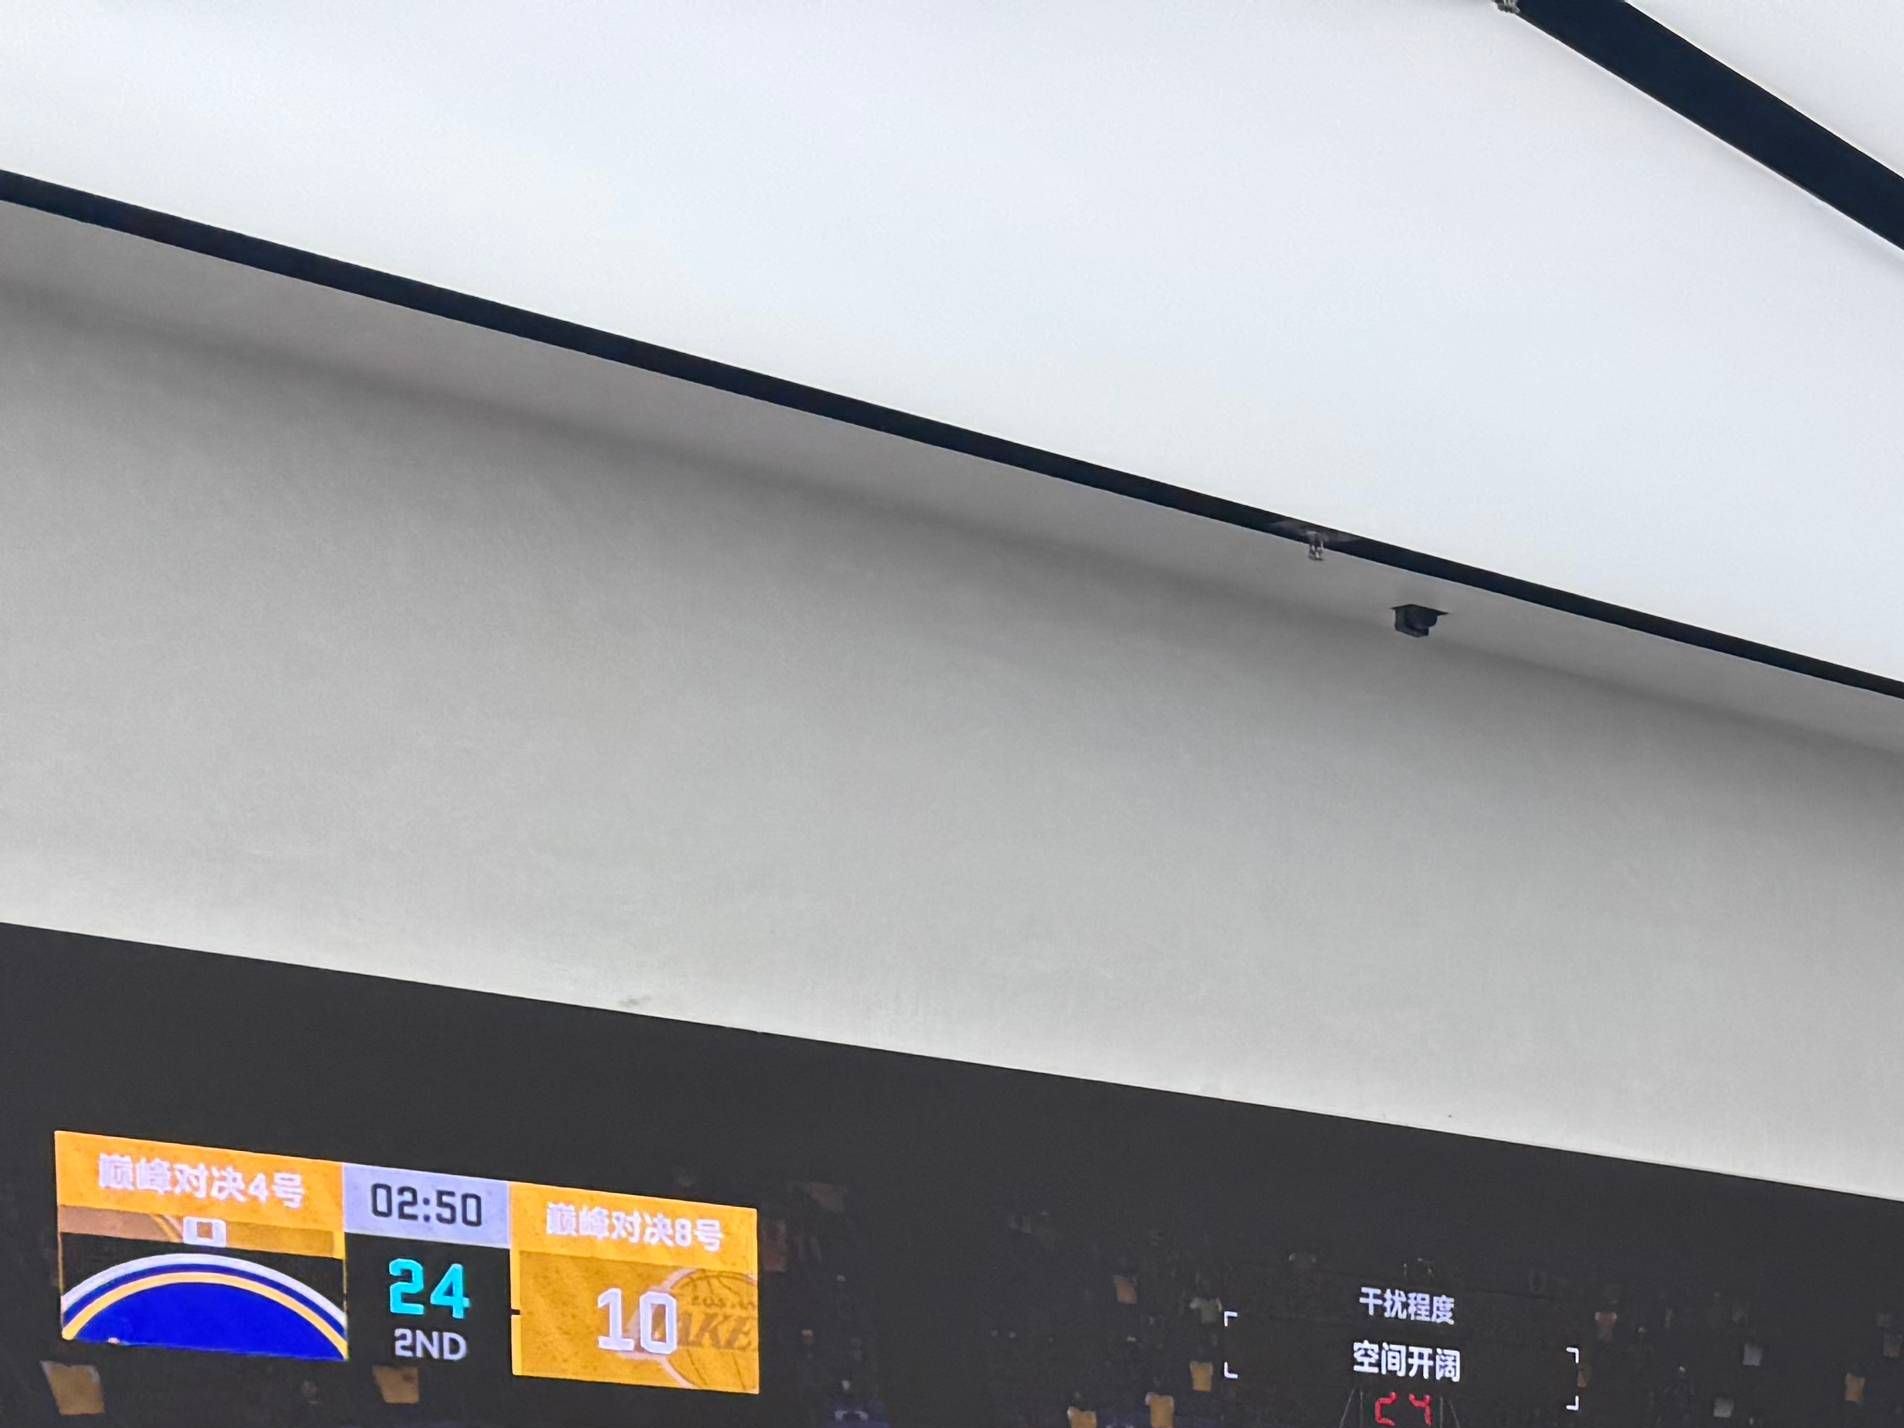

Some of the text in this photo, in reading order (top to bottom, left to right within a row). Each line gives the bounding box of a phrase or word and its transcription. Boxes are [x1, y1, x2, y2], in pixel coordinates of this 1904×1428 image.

[98, 1153, 305, 1209] 巅峰对决4号
[369, 1181, 483, 1228] 02:50
[546, 1203, 725, 1253] 巅峰对决8号
[387, 1257, 470, 1319] 24
[1359, 1286, 1455, 1325] 干扰程度
[394, 1328, 468, 1362] 2ND
[597, 1287, 678, 1355] 10
[1352, 1340, 1461, 1382] 空间开阔
